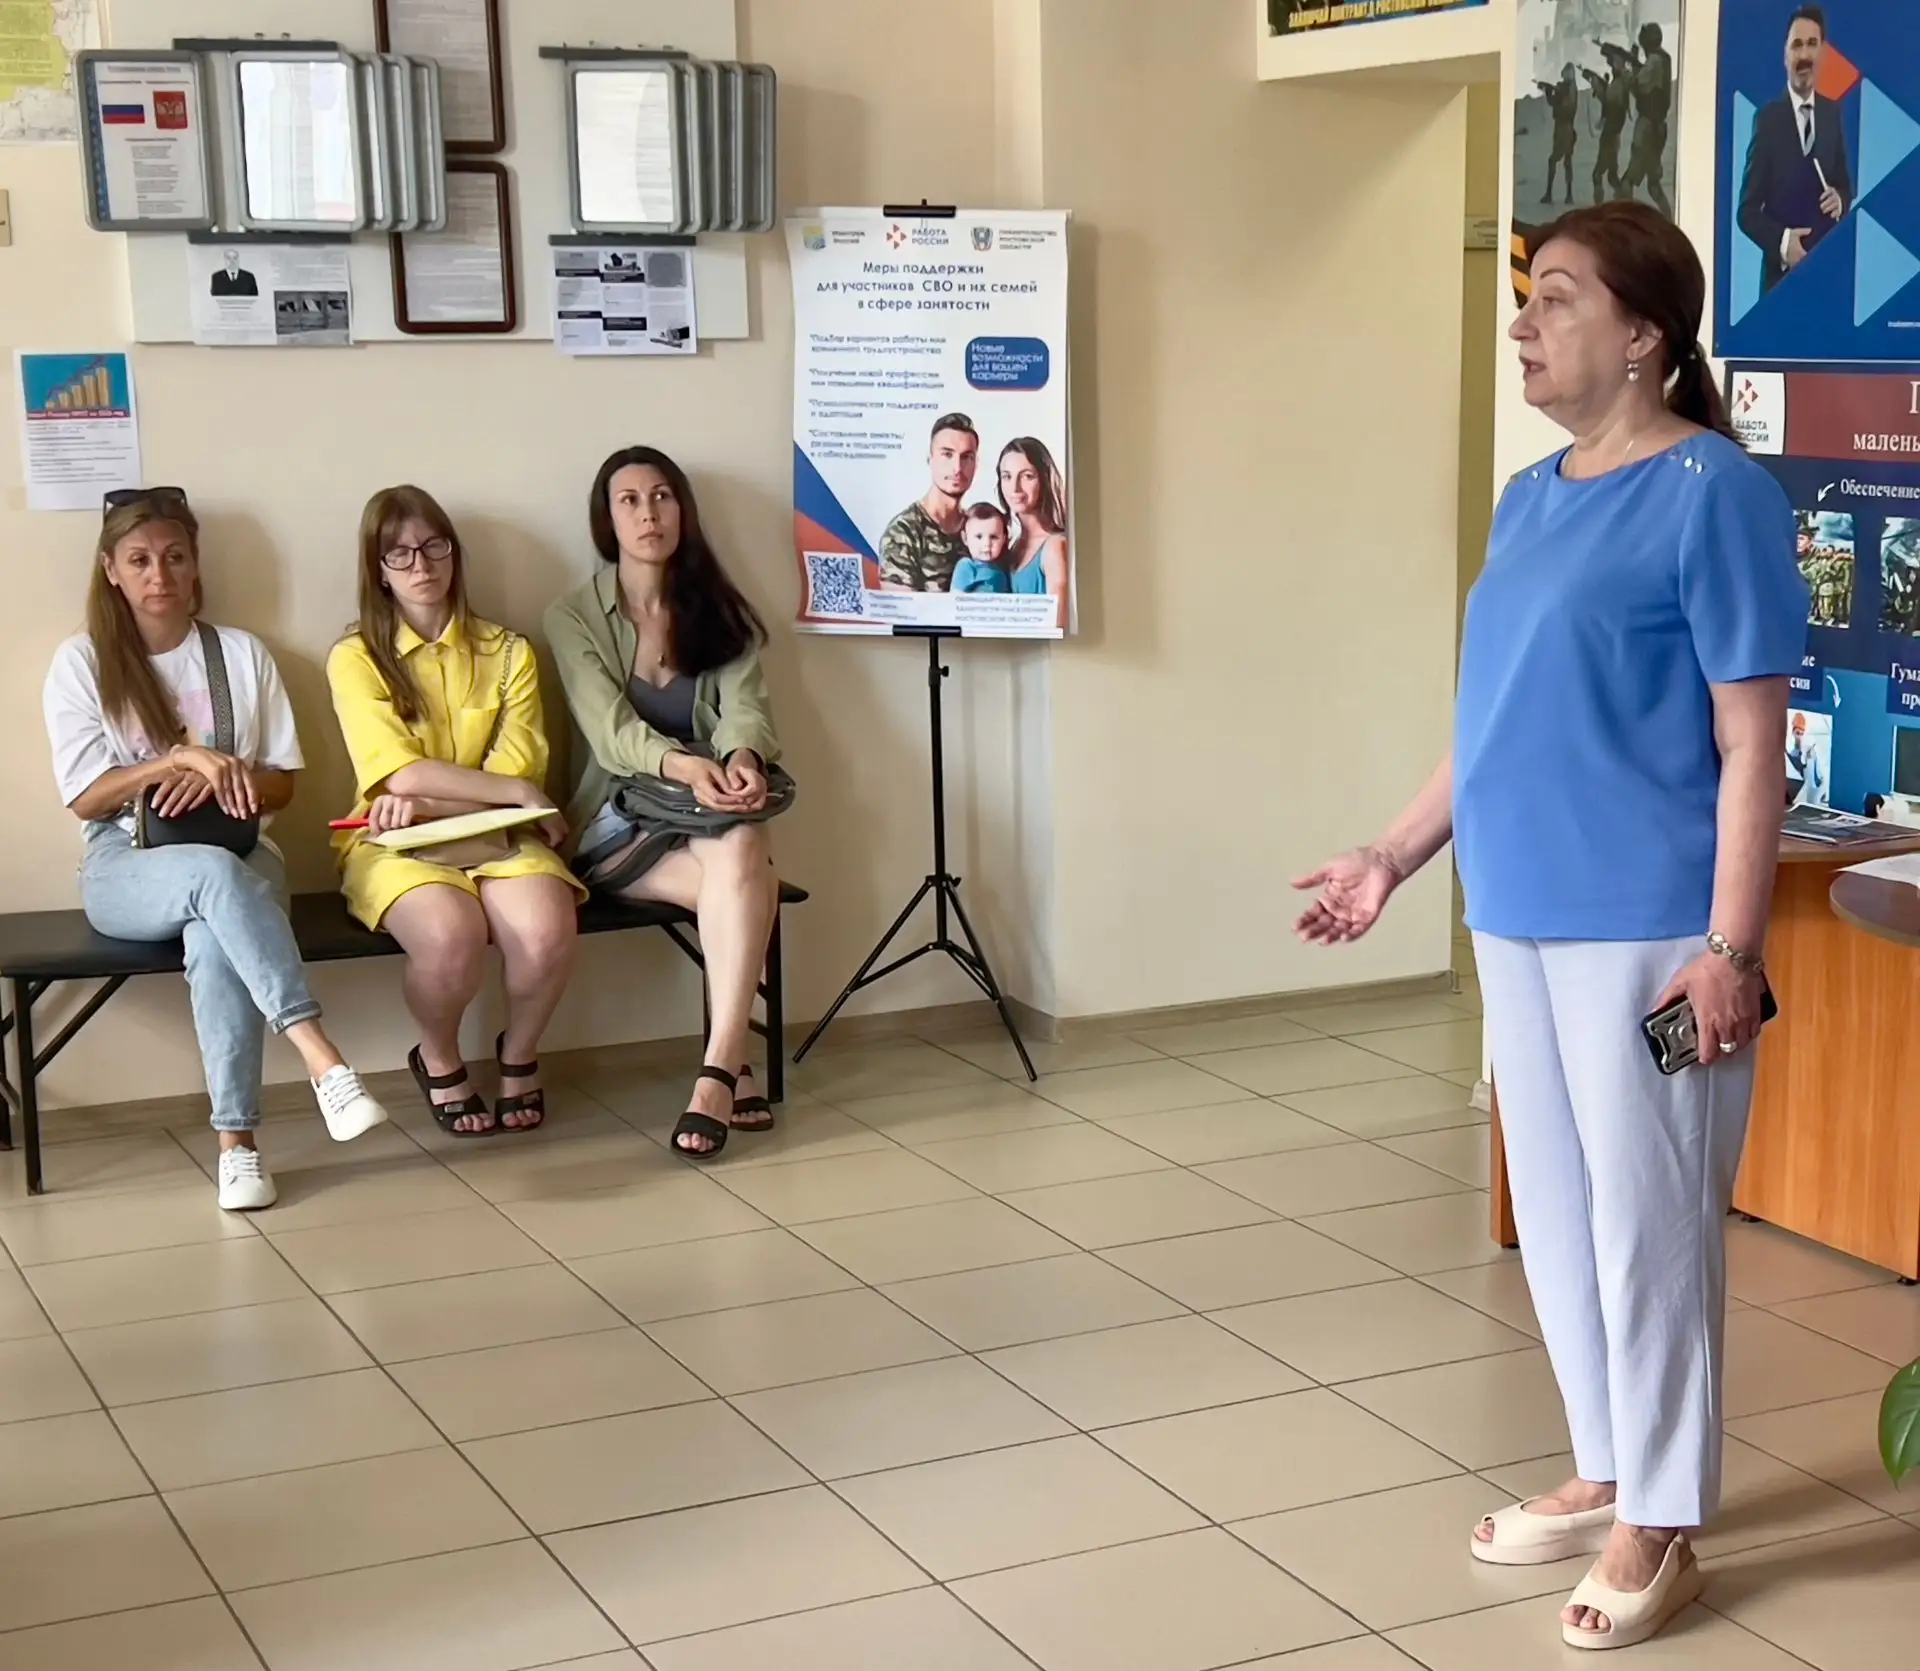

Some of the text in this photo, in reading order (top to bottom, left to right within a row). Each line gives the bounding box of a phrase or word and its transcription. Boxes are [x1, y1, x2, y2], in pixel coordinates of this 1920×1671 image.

[911, 228, 947, 236] РАБОТА
[863, 261, 984, 276] Меры поддержки
[817, 280, 1037, 293] для участников СВО и их семей
[858, 298, 990, 311] в сфере занятости
